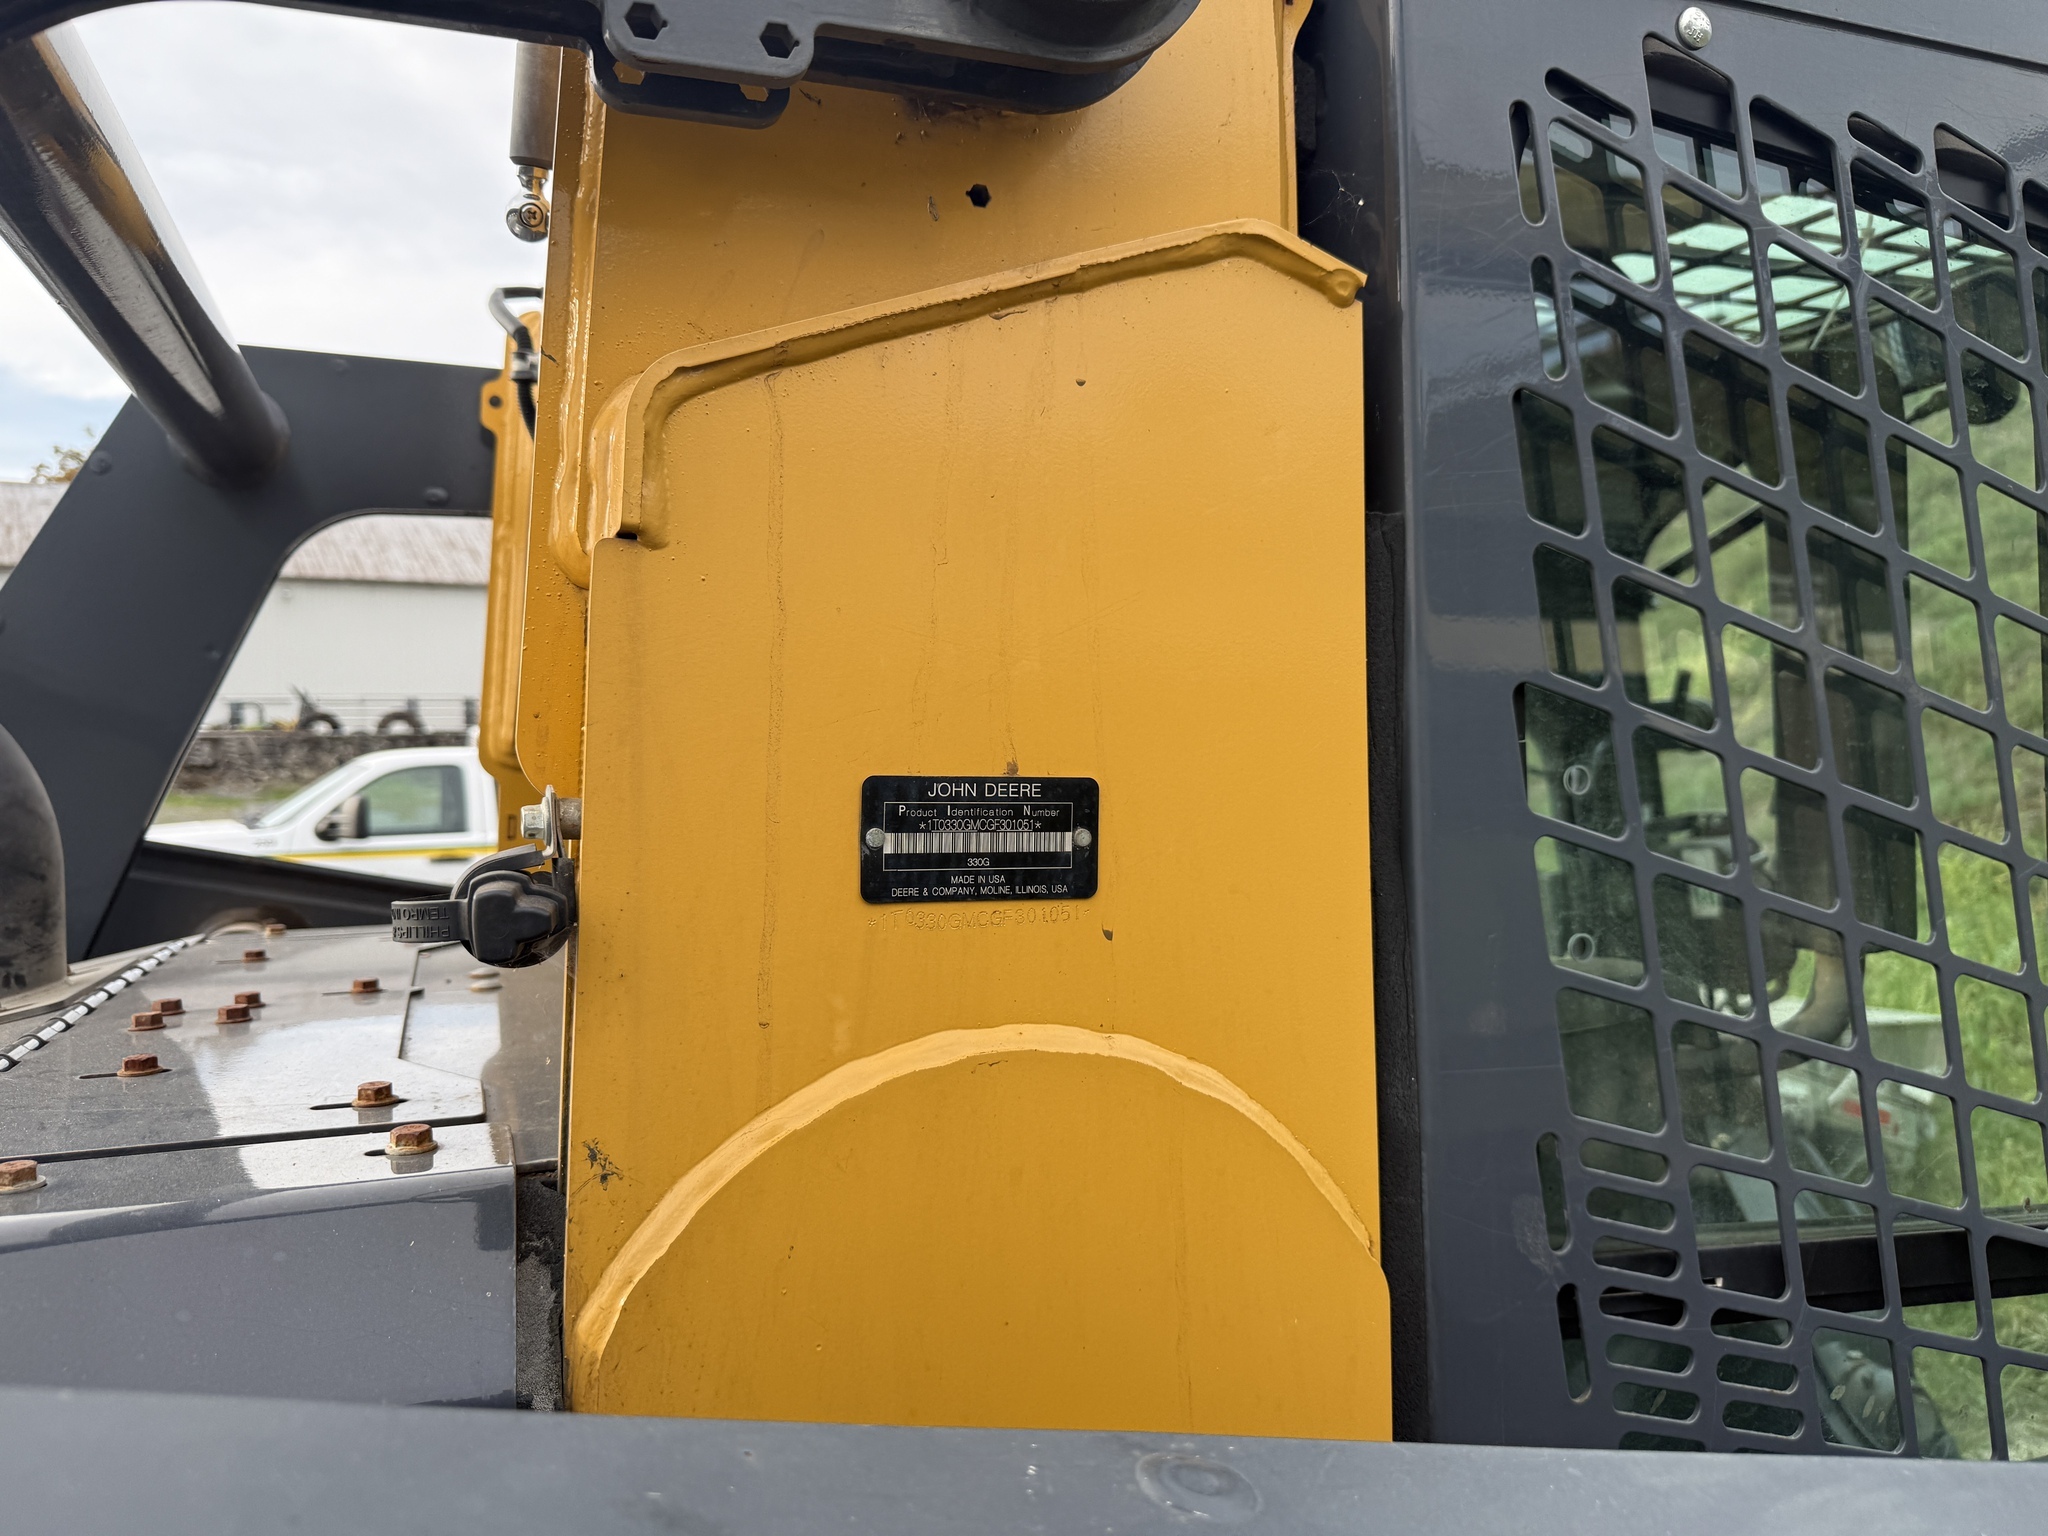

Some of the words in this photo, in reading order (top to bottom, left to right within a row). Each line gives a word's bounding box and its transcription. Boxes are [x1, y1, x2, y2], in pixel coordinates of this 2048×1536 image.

[928, 782, 977, 798] JOHN
[985, 783, 1042, 798] DEERE
[898, 804, 937, 817] Product
[947, 804, 1014, 817] Identification
[1023, 804, 1060, 817] Number
[967, 857, 990, 867] 330G
[951, 875, 975, 885] MADE
[978, 875, 986, 884] IN
[988, 875, 1006, 884] USA
[891, 887, 919, 897] DEERE
[922, 887, 929, 896] &
[932, 886, 978, 897] COMPANY,
[980, 886, 1013, 896] MOLINE,
[1015, 885, 1049, 895] ILLINOIS,
[1051, 884, 1069, 894] USA
[402, 906, 450, 920] TEMRO
[397, 926, 451, 939] PHILLIPS
